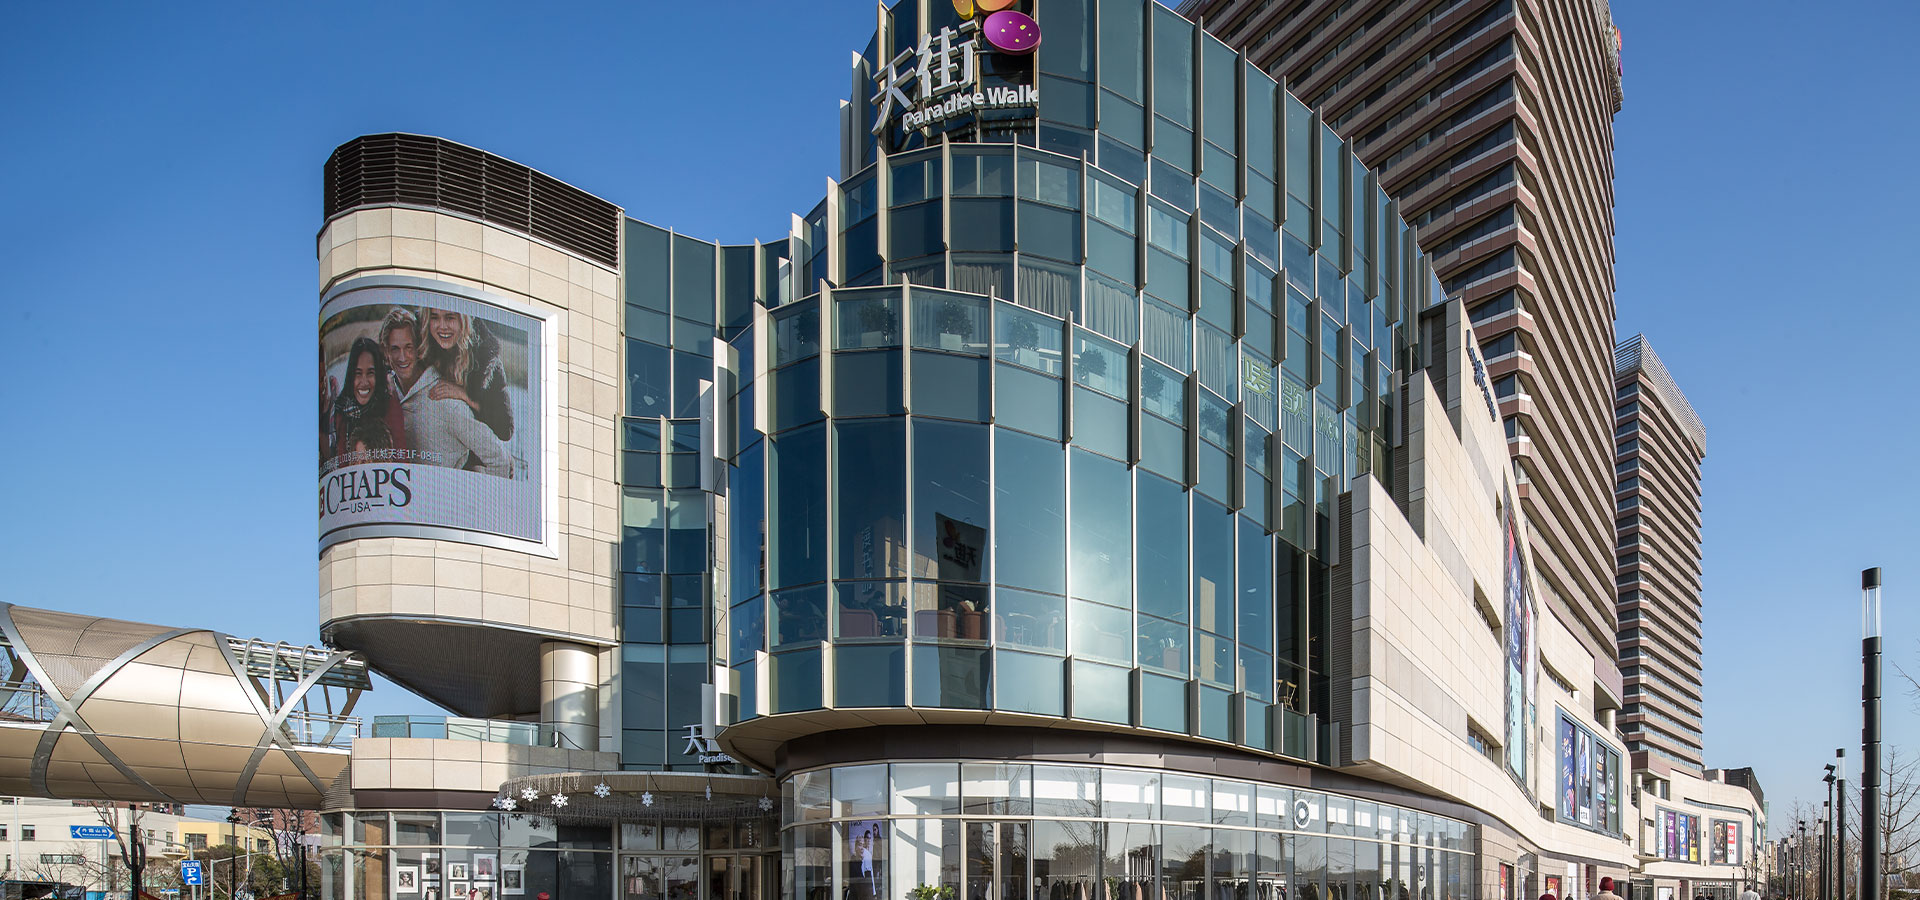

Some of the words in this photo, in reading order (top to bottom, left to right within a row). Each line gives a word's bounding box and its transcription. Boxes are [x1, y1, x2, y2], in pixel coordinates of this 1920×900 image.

[870, 19, 979, 135] 天街
[902, 92, 985, 134] Paradise
[986, 84, 1038, 109] Walk
[326, 467, 412, 515] CHAPS
[349, 501, 371, 515] USA
[186, 867, 197, 877] P
